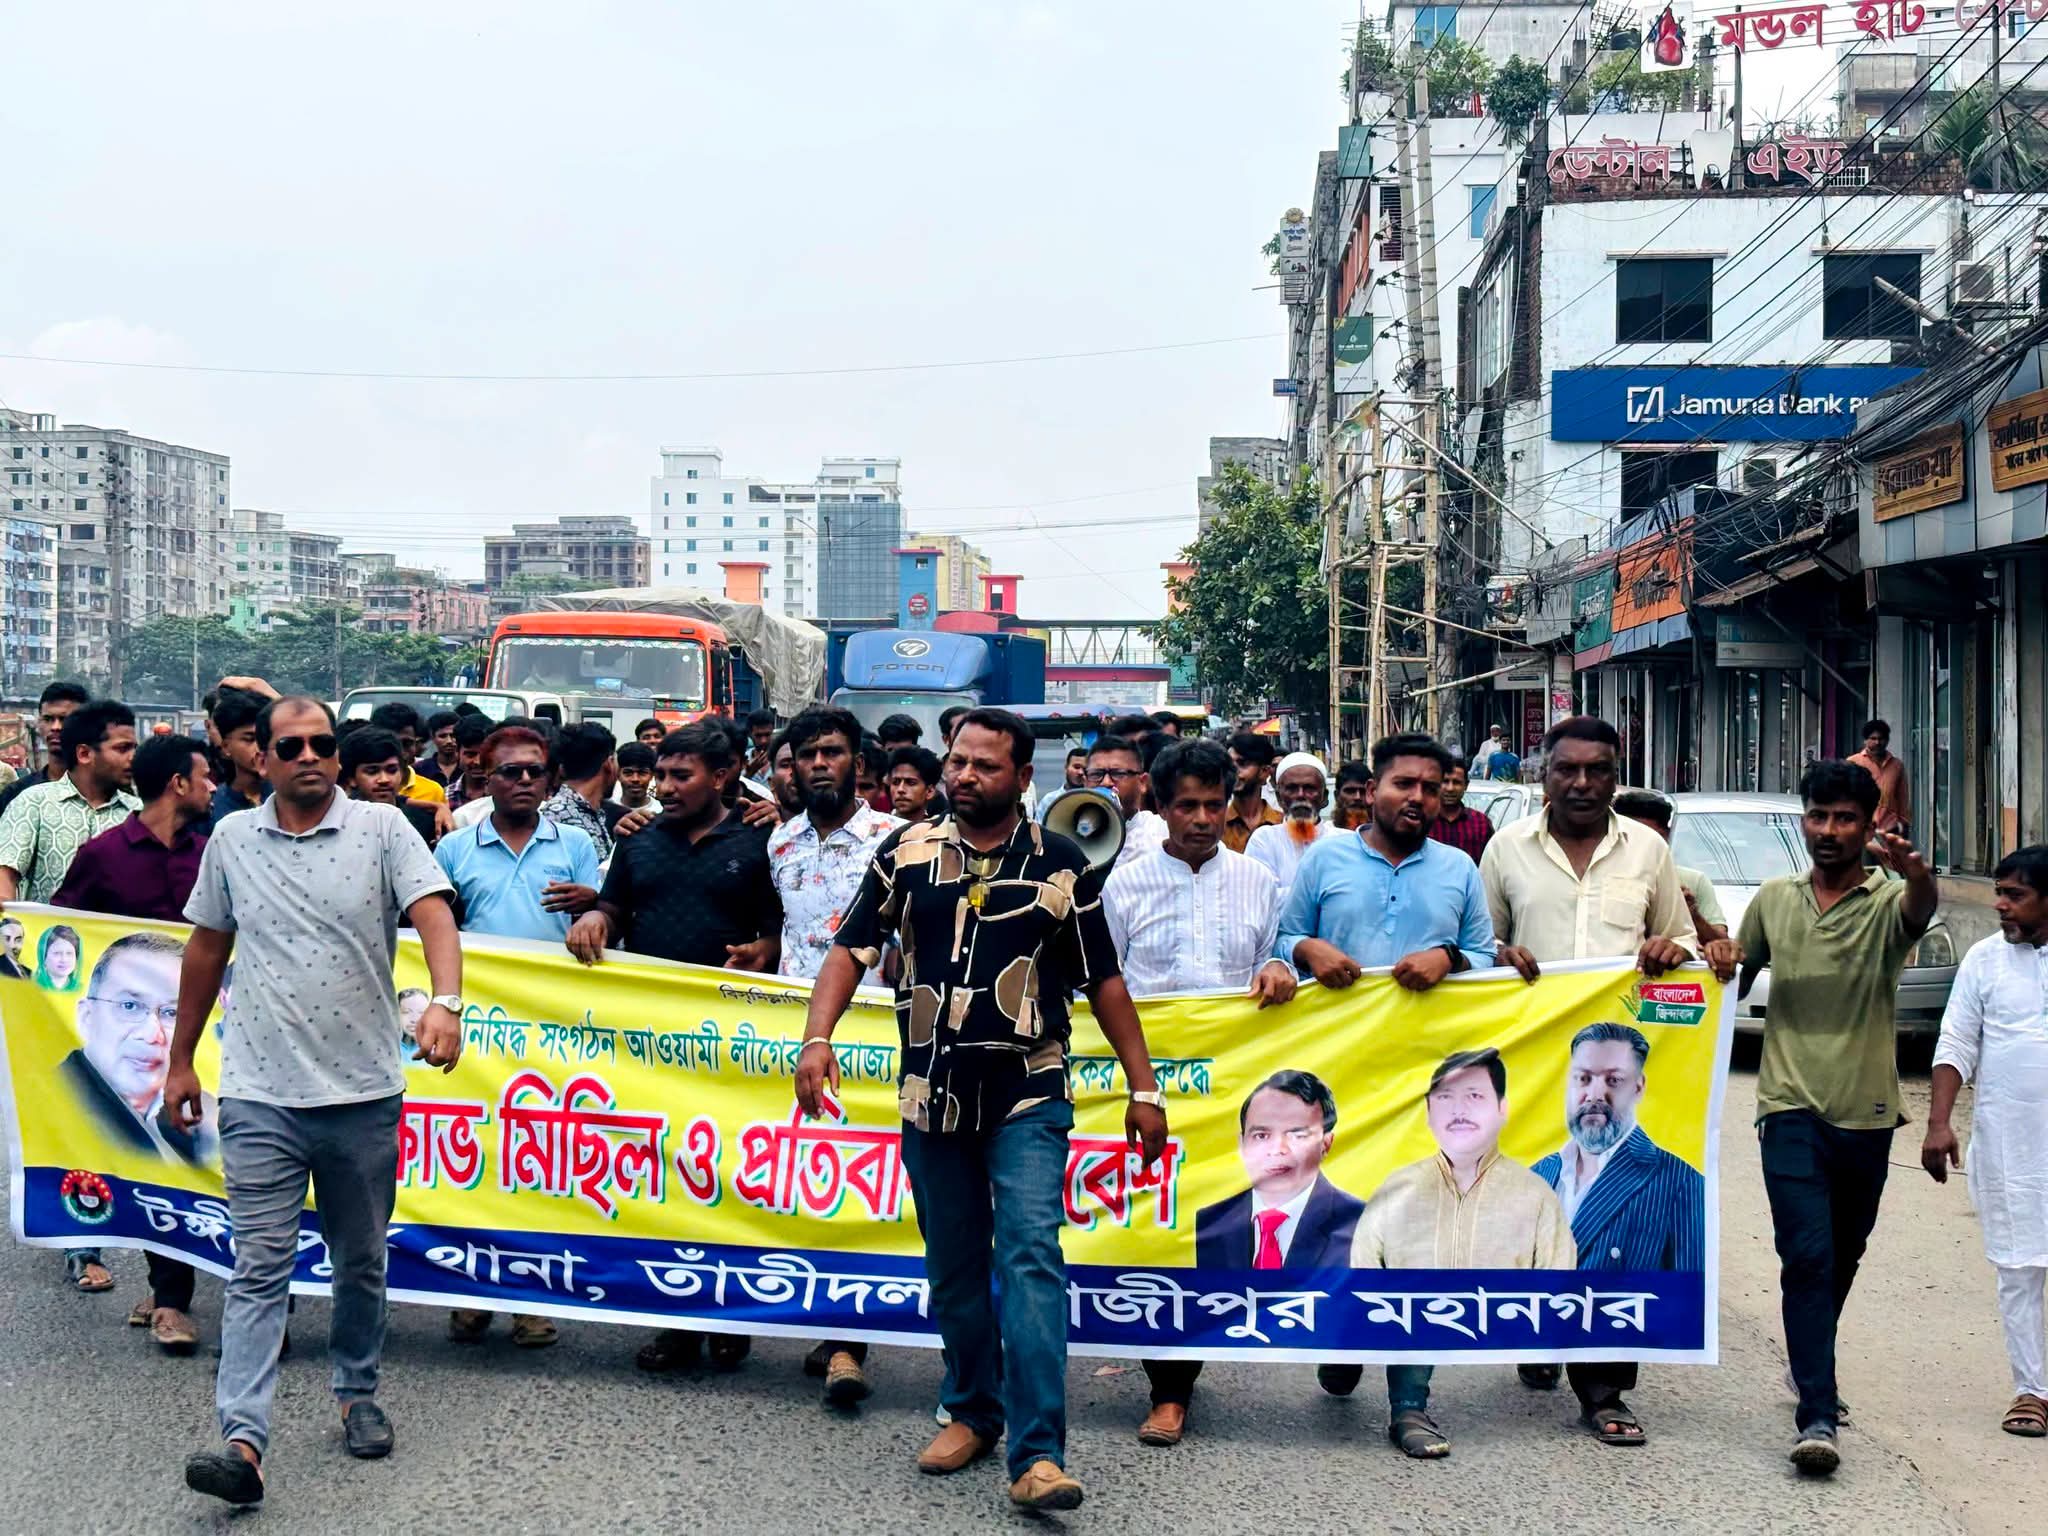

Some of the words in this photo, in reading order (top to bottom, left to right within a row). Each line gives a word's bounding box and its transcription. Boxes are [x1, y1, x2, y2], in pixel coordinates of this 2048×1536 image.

[1671, 393, 1774, 416] Jamuna
[1652, 988, 1698, 1002] বাংলাদেশ
[460, 1005, 532, 1060] নিষিদ্ধ
[539, 1009, 617, 1064] সংগঠন
[623, 1020, 723, 1071] আওয়ামী
[499, 1073, 666, 1214] মিছিল
[676, 1119, 716, 1200] ও
[635, 1247, 930, 1319] তাঁতীদল
[1352, 1285, 1660, 1341] মহানগর
